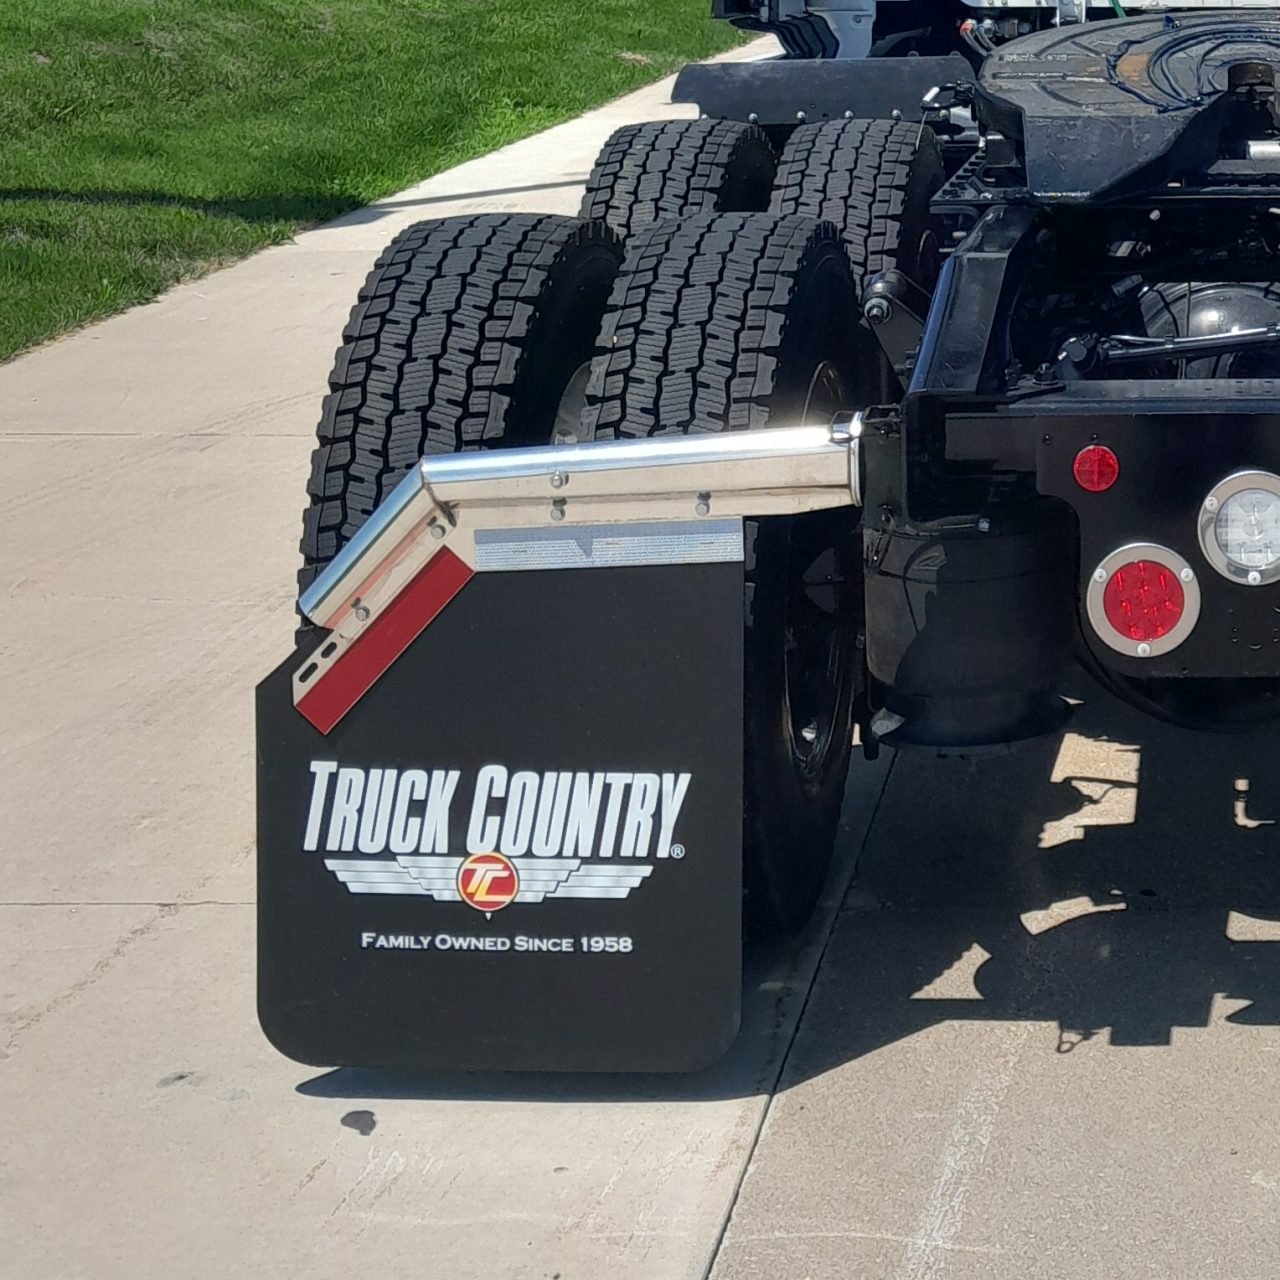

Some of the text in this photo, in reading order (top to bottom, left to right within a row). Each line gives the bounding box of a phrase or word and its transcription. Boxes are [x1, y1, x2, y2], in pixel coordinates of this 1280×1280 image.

[303, 761, 461, 855] TRUCK
[361, 932, 634, 953] FAMILY OWNED SINCE 1958
